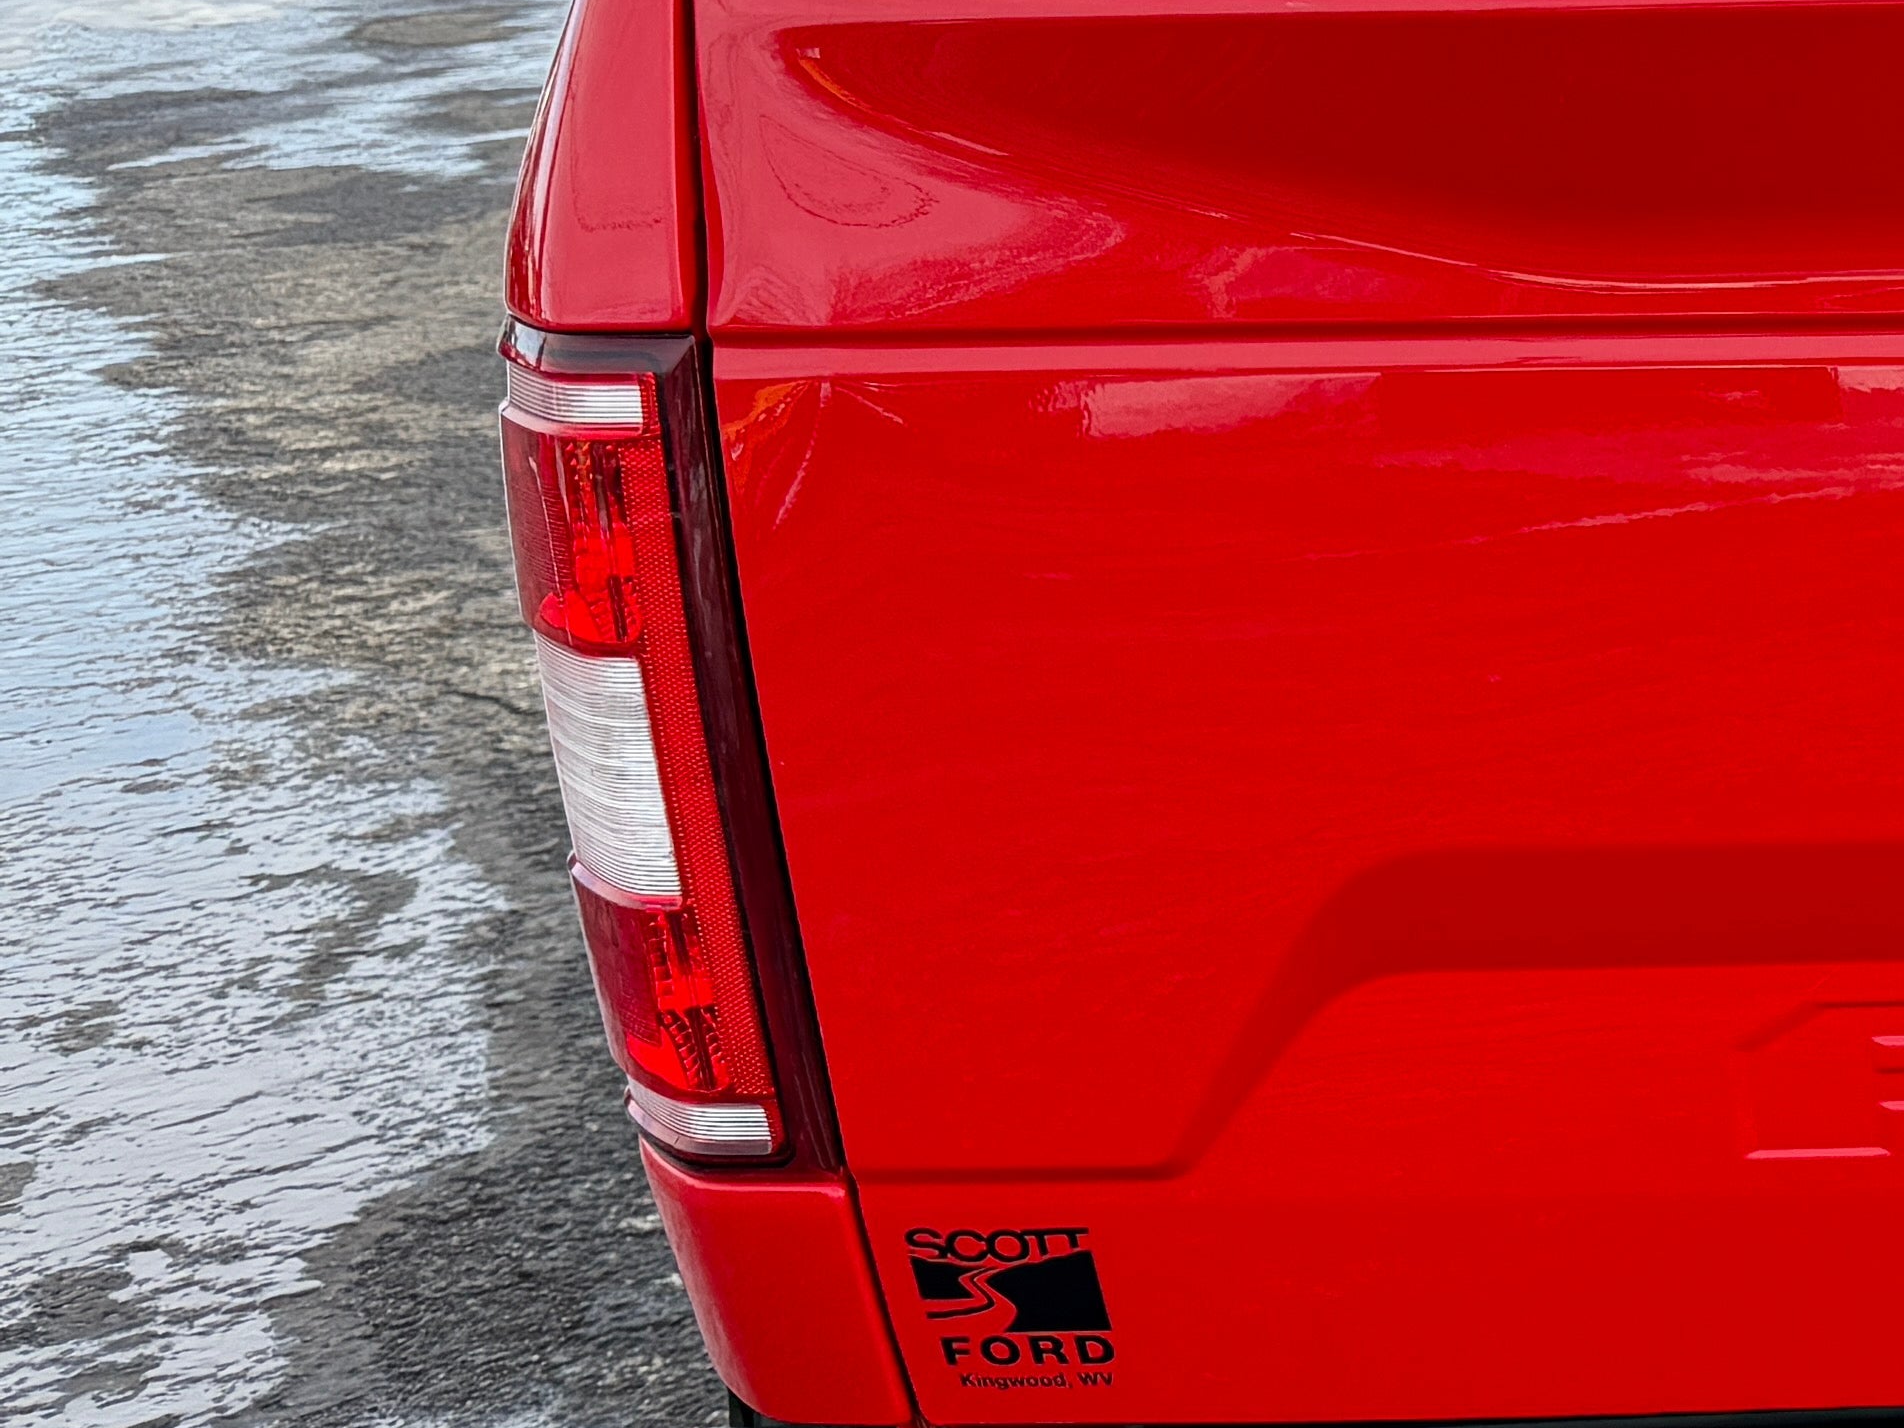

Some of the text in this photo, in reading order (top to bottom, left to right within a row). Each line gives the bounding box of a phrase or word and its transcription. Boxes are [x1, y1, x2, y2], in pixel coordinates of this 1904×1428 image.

[903, 1227, 1090, 1263] SCOTT
[940, 1335, 1116, 1366] FORD
[960, 1372, 1114, 1390] Kingwood, WV
